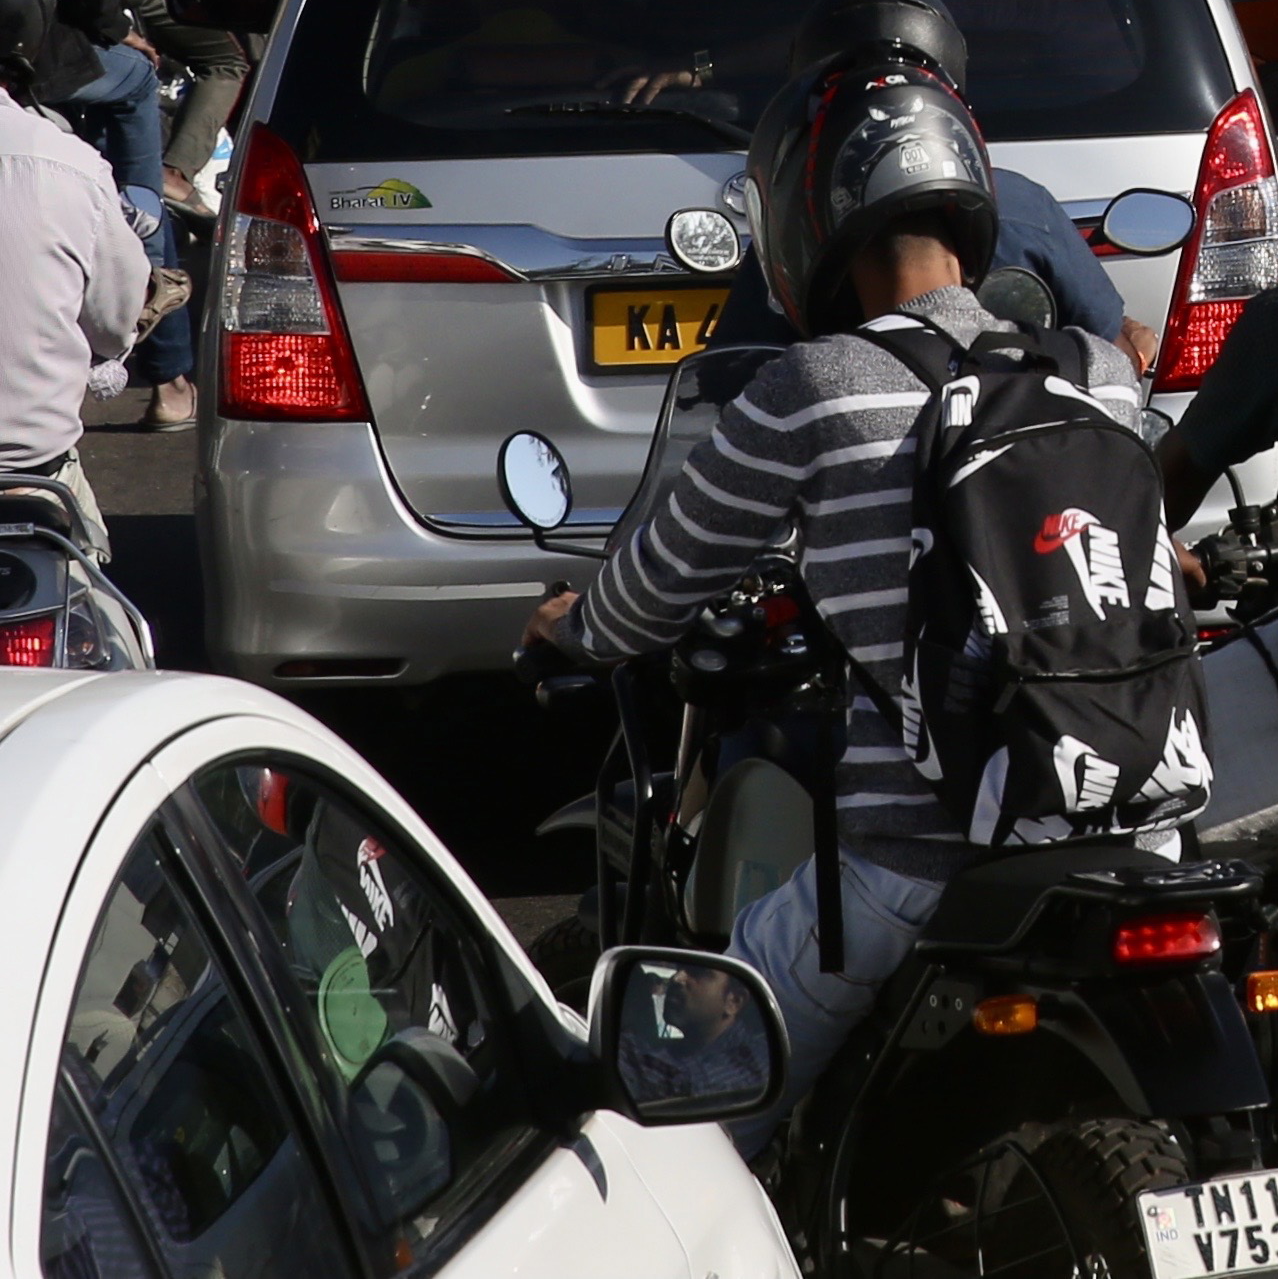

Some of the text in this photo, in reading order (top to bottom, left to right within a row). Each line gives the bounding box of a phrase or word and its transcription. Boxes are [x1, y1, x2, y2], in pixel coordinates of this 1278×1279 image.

[330, 196, 385, 210] Bharat
[625, 304, 684, 352] KA
[1087, 521, 1131, 611] NIKE
[1076, 752, 1121, 814] NIK
[1156, 1229, 1180, 1244] IND
